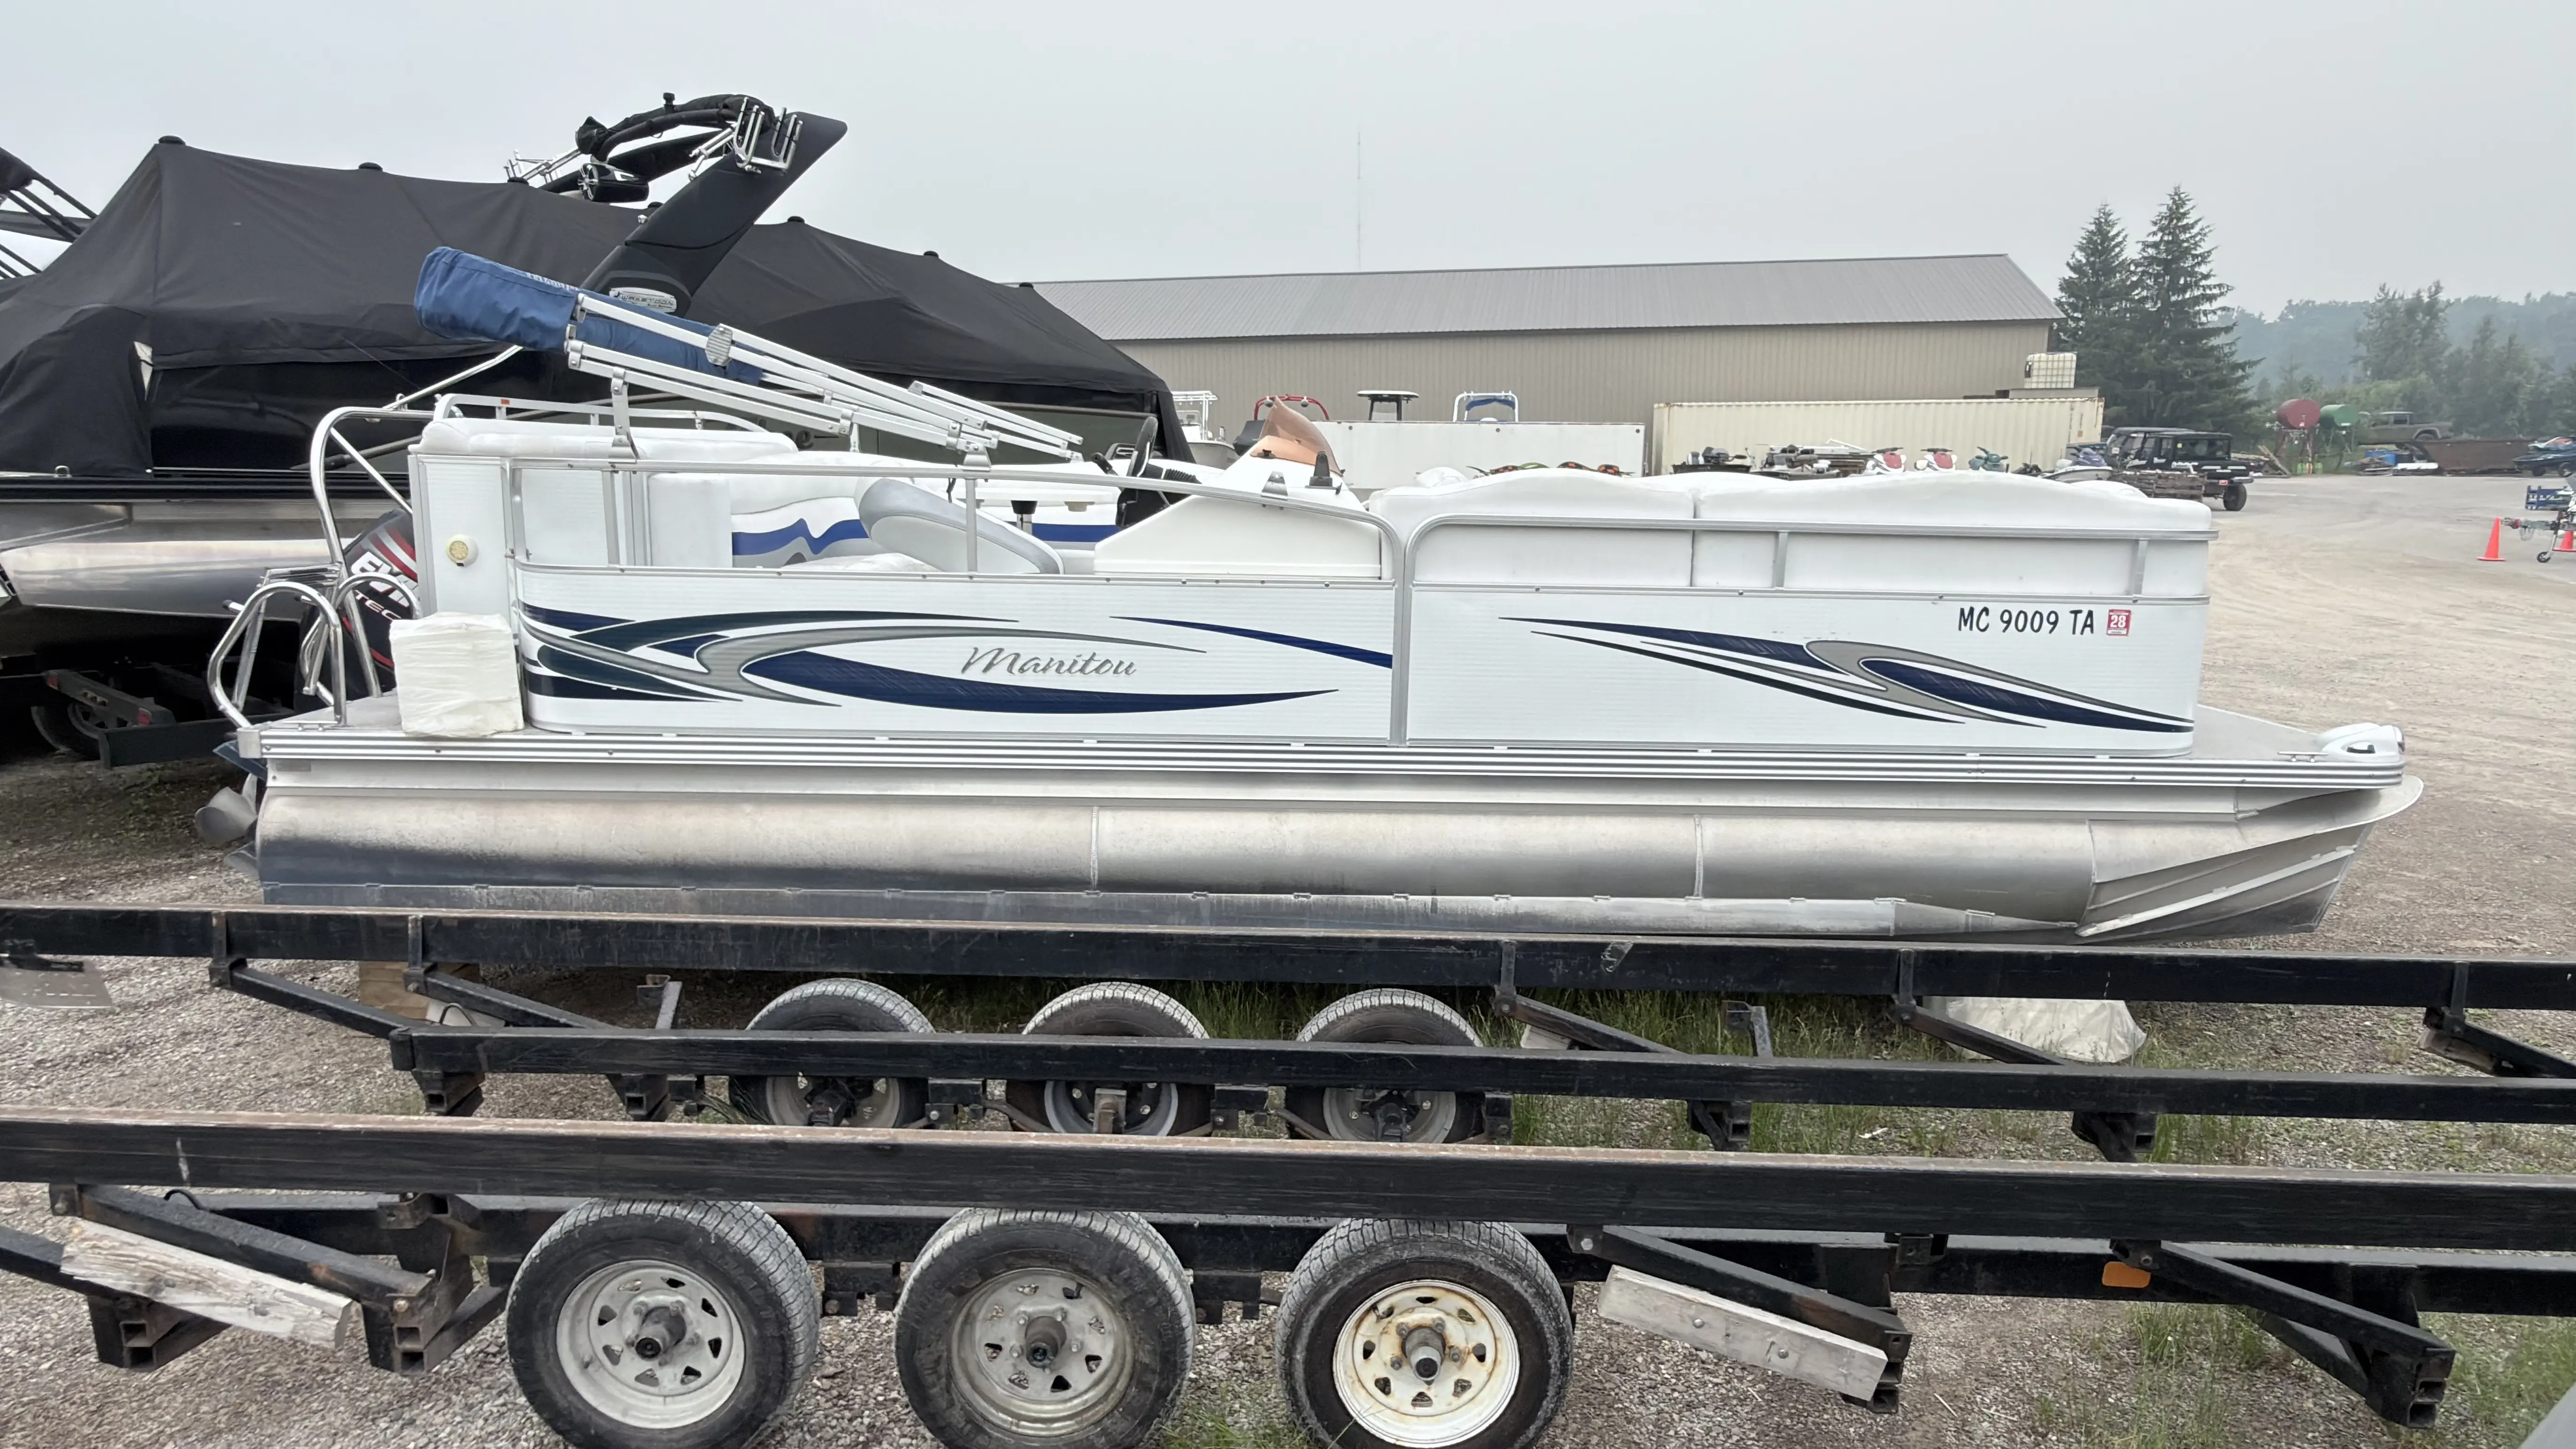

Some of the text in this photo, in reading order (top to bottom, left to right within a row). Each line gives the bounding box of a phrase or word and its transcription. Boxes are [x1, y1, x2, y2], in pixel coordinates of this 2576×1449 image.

[1958, 606, 2094, 635] MC 9009 TA
[2110, 615, 2127, 628] 28
[961, 647, 1137, 676] Manitou
